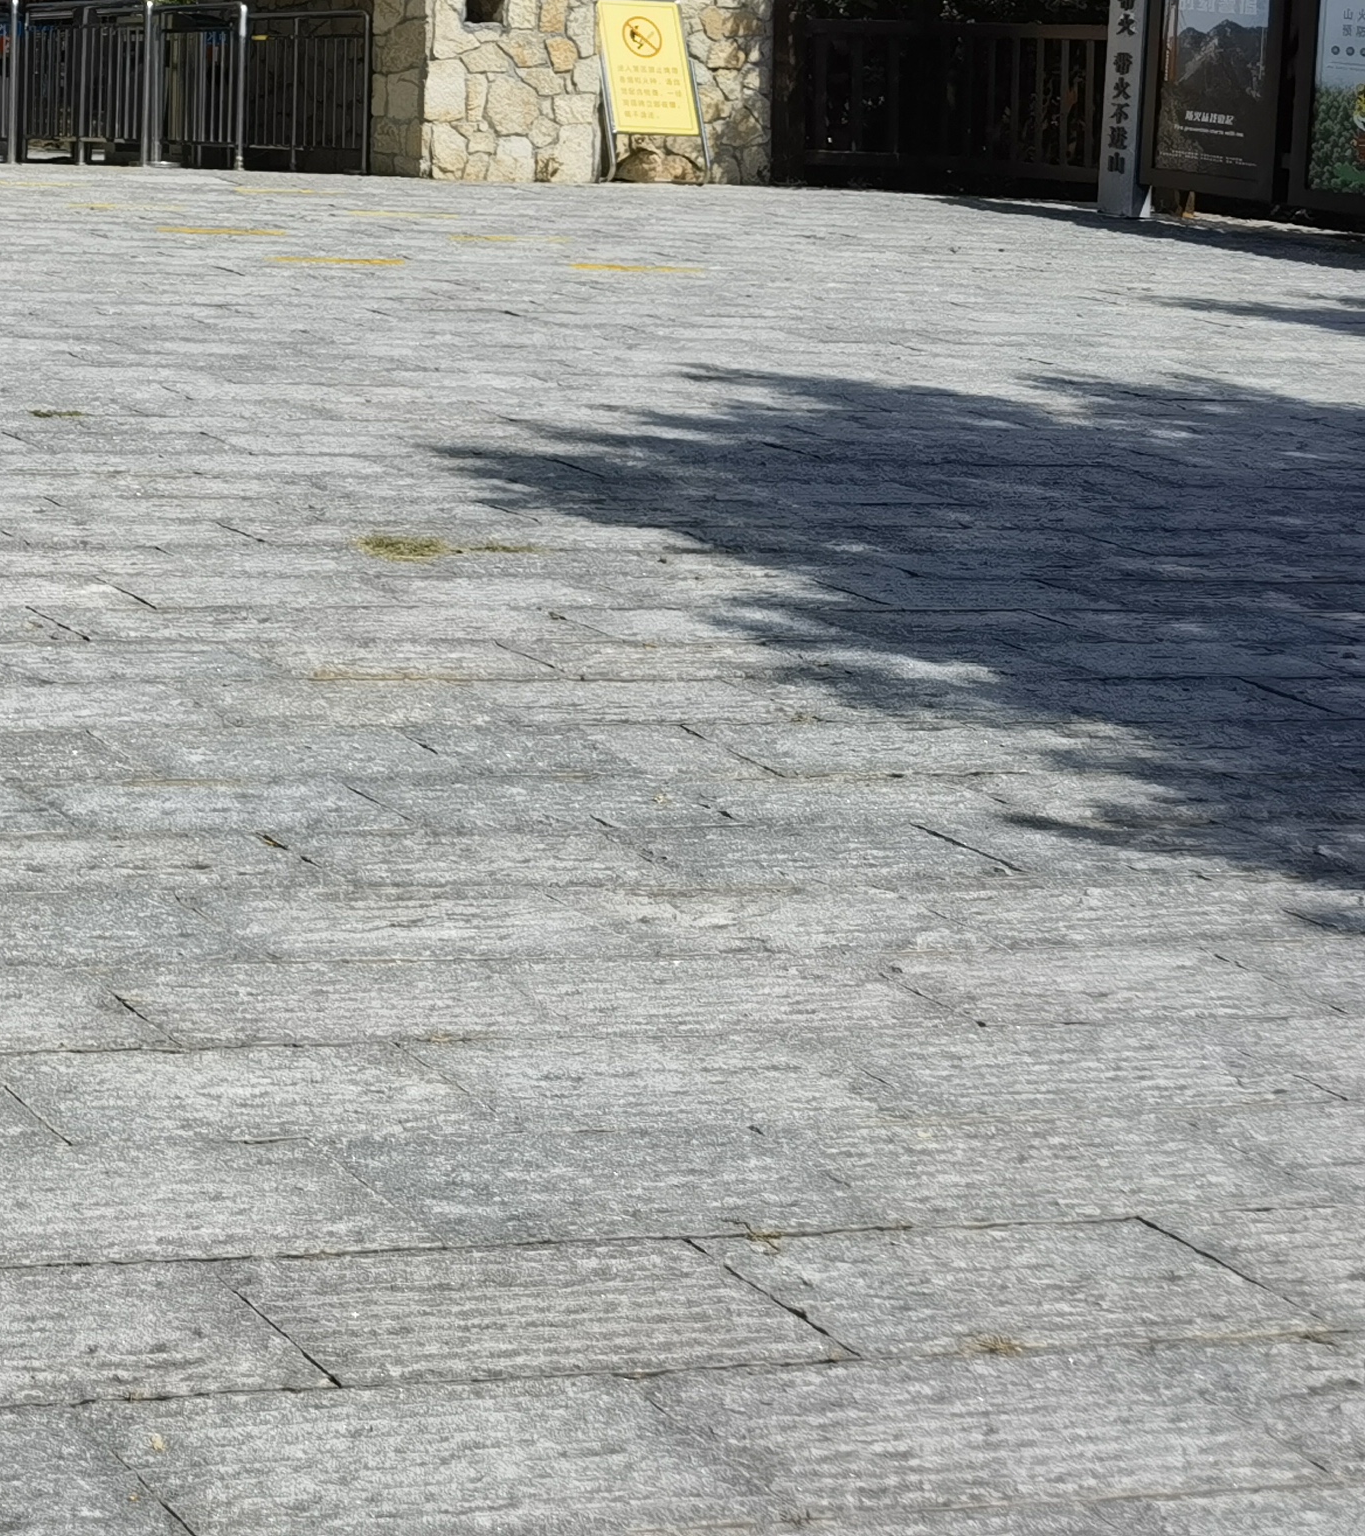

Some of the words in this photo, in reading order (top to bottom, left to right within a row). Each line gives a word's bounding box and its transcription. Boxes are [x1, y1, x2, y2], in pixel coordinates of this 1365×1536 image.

[1106, 52, 1133, 175] 带火不进山
